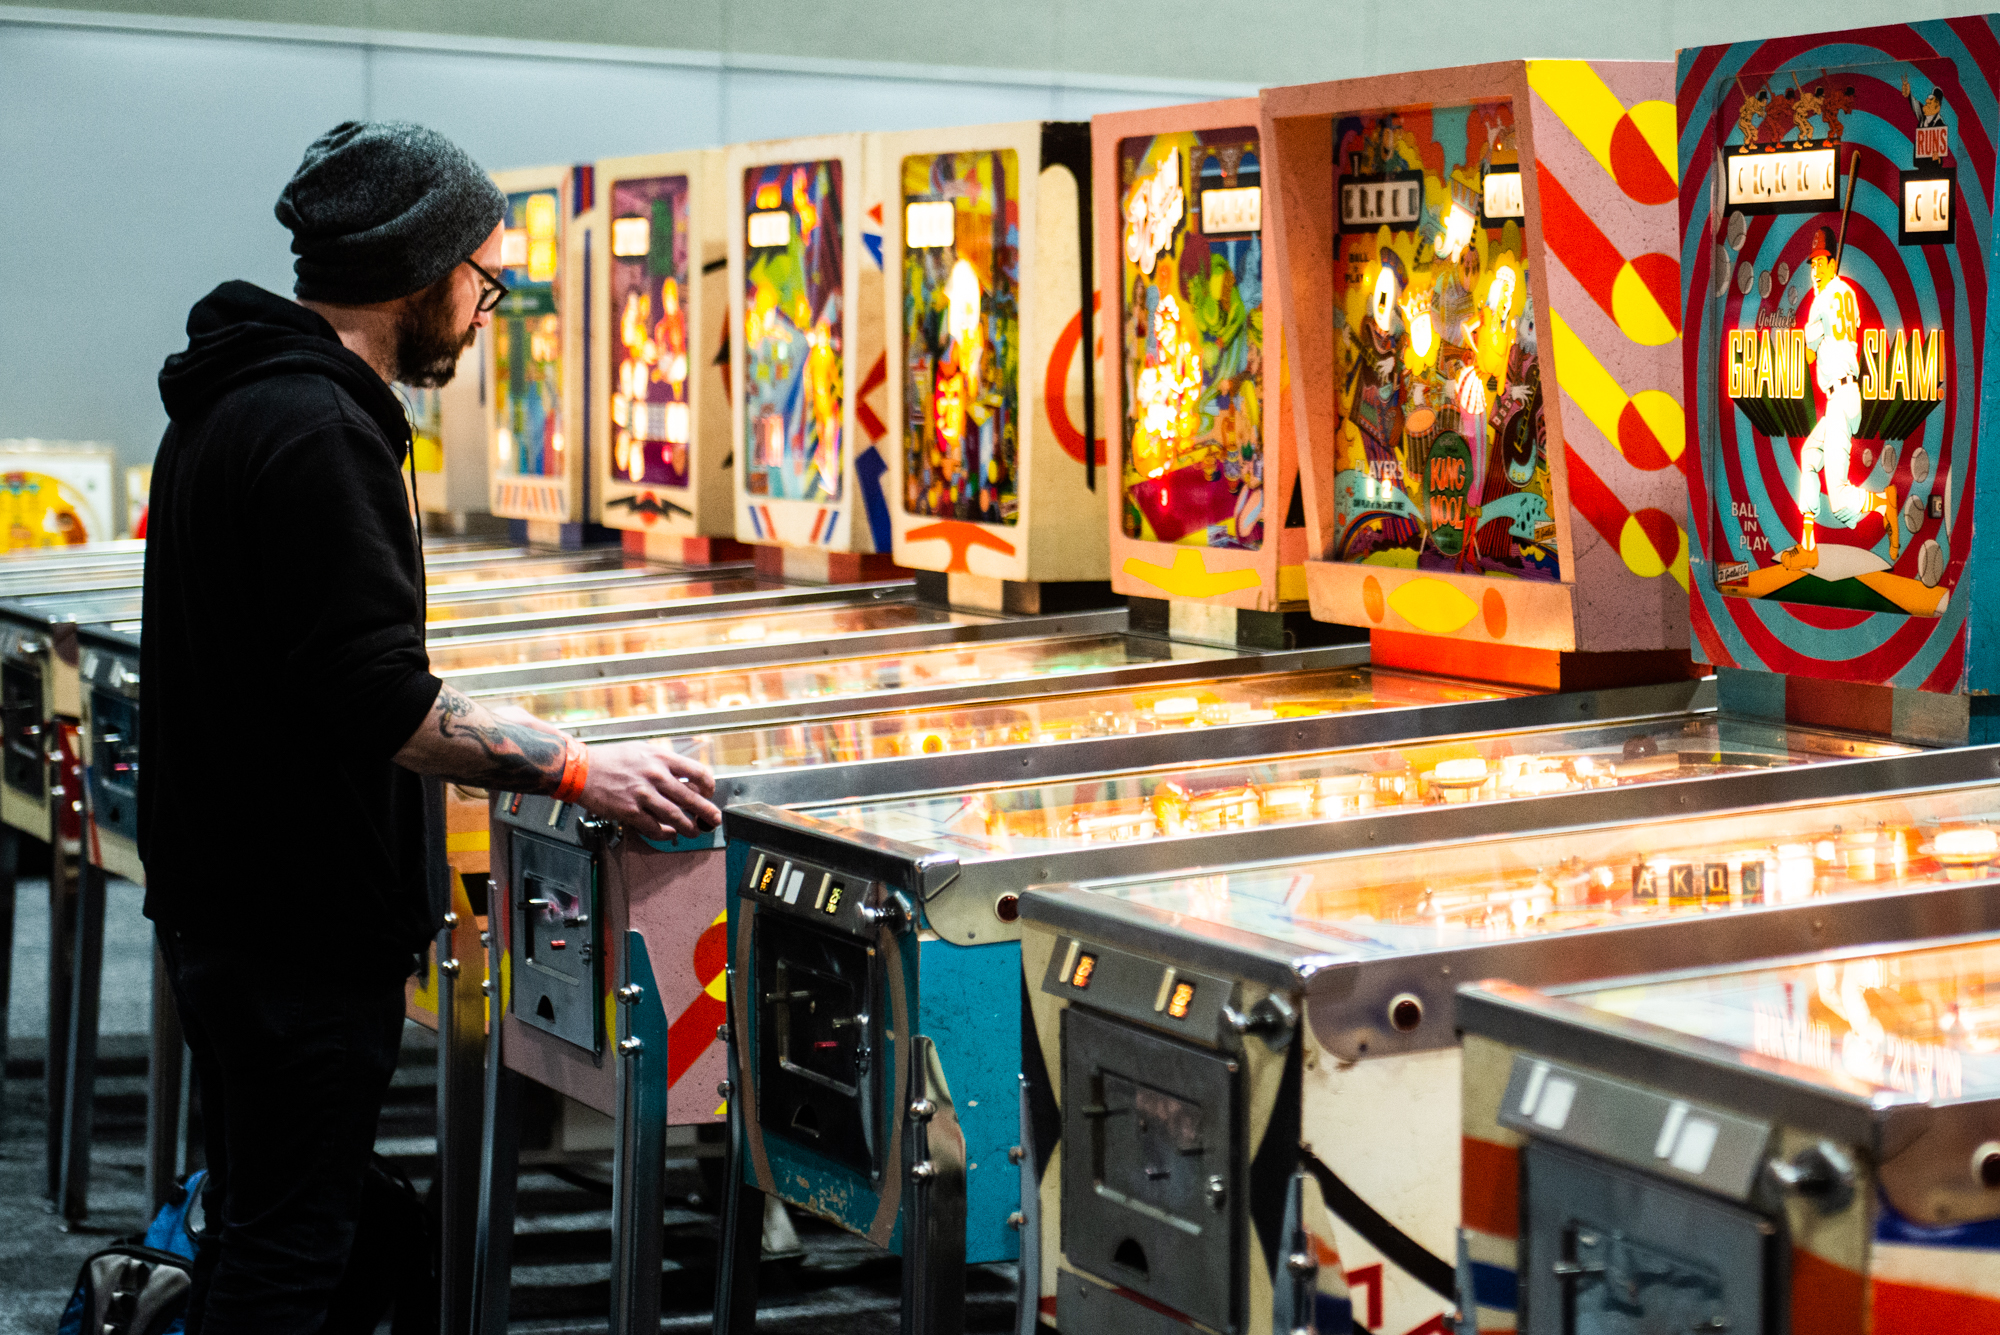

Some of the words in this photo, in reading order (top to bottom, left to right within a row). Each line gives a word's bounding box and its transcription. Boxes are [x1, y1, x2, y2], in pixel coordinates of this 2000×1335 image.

[1917, 128, 1947, 156] RUNS
[1830, 290, 1857, 343] 39
[1728, 329, 1805, 400] GRAND
[1862, 328, 1946, 401] SLAM!
[1355, 459, 1404, 481] PLAYERS
[1430, 456, 1466, 492] KING
[1381, 478, 1393, 500] 2
[1731, 501, 1759, 518] BALL
[1744, 520, 1757, 532] IN
[1740, 534, 1769, 552] PLAY
[1636, 869, 1654, 894] A
[1672, 868, 1689, 893] K
[1707, 867, 1728, 893] Q
[1746, 863, 1761, 891] J
